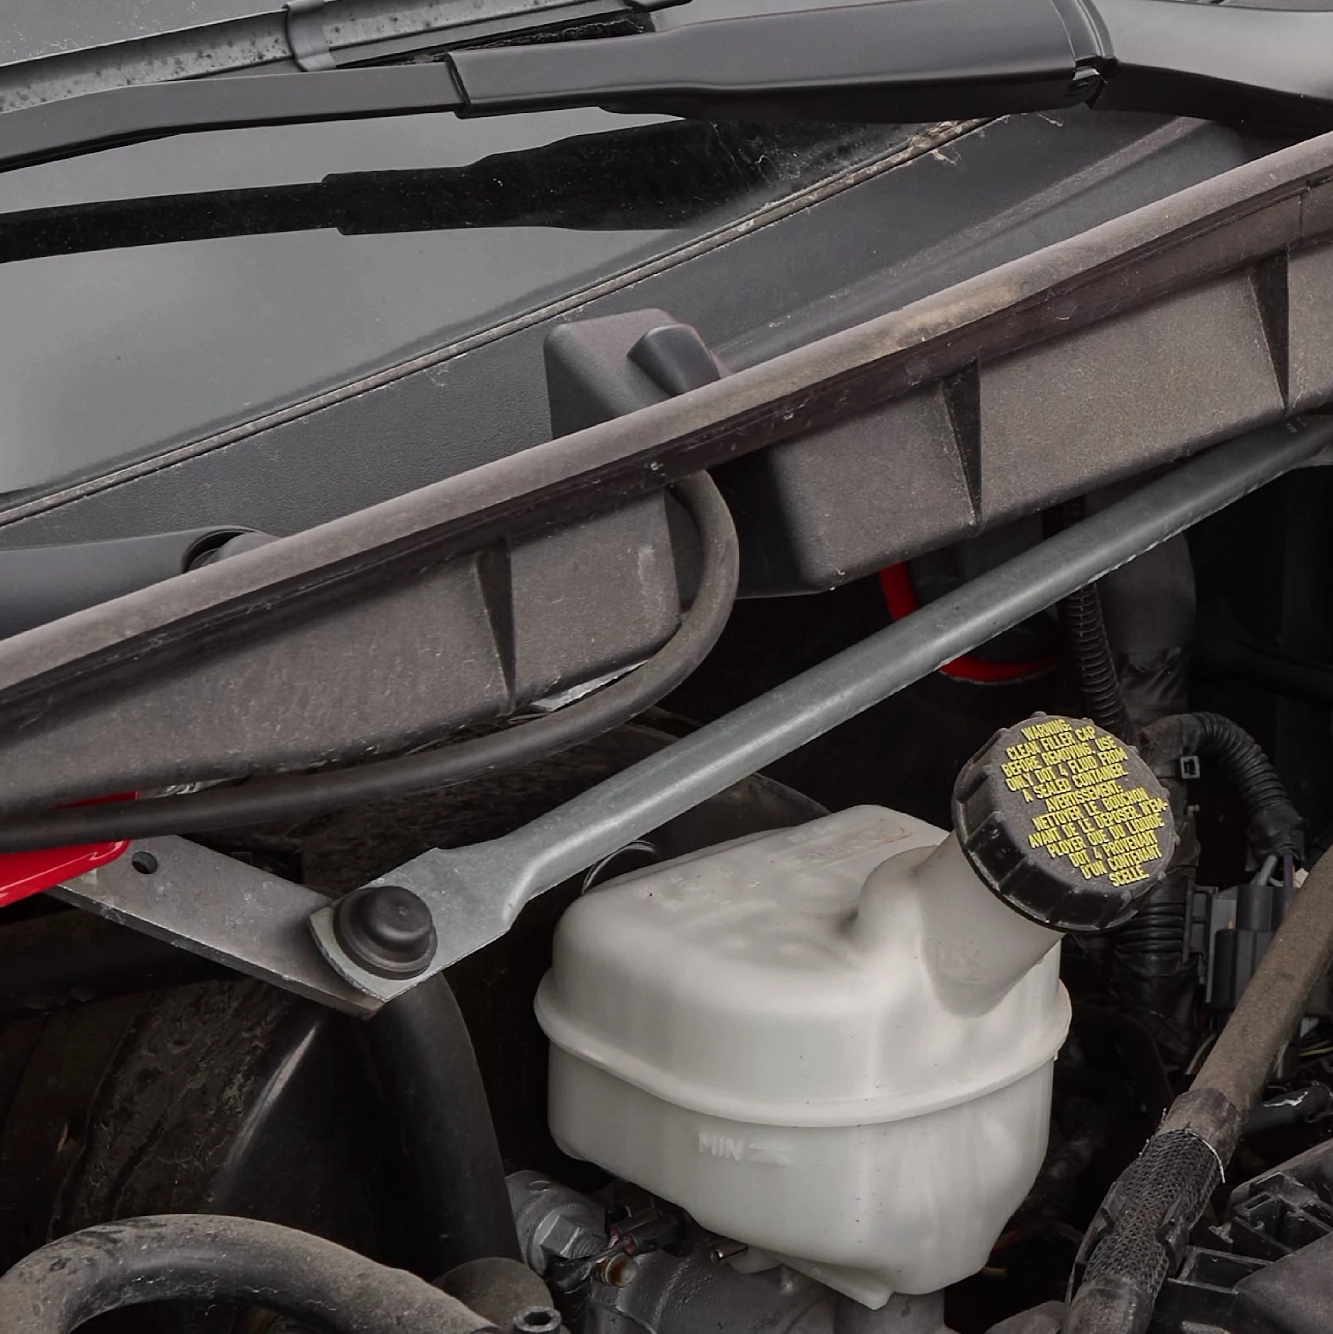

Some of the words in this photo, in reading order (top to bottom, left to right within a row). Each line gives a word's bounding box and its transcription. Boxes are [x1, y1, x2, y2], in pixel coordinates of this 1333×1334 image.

[1006, 740, 1040, 761] CLEAN
[1040, 731, 1076, 752] FILLER
[1074, 725, 1097, 742] CAP
[1021, 718, 1073, 741] WARNING:
[1000, 754, 1042, 778] BEFORE
[1040, 738, 1096, 768] REMOVING.
[1094, 733, 1116, 752] USE
[1005, 772, 1034, 792] ONLY
[1034, 766, 1057, 783] DOT
[1057, 763, 1068, 777] 4
[1067, 754, 1098, 775] FLUID
[1097, 745, 1128, 766] FROM
[1021, 788, 1033, 802] A
[1032, 777, 1072, 799] SEALED
[1044, 777, 1123, 813] AVERTISSEMENT:
[1031, 804, 1083, 831] NETTOYER
[1082, 800, 1100, 816] LE
[1101, 785, 1149, 811] BOUCHON
[1027, 826, 1061, 848] AVANT
[1061, 822, 1079, 838] DE
[1077, 817, 1095, 834] LE
[1046, 834, 1087, 858] PLOYER
[1086, 828, 1108, 846] QUE
[1107, 823, 1126, 840] DU
[1125, 811, 1165, 835] LIQUIDE
[1067, 849, 1090, 867] DOT
[1092, 846, 1103, 860] 4
[1100, 829, 1158, 858] PROVENANT
[1106, 843, 1162, 871] CONTENANT
[698, 1132, 744, 1162] MIN
